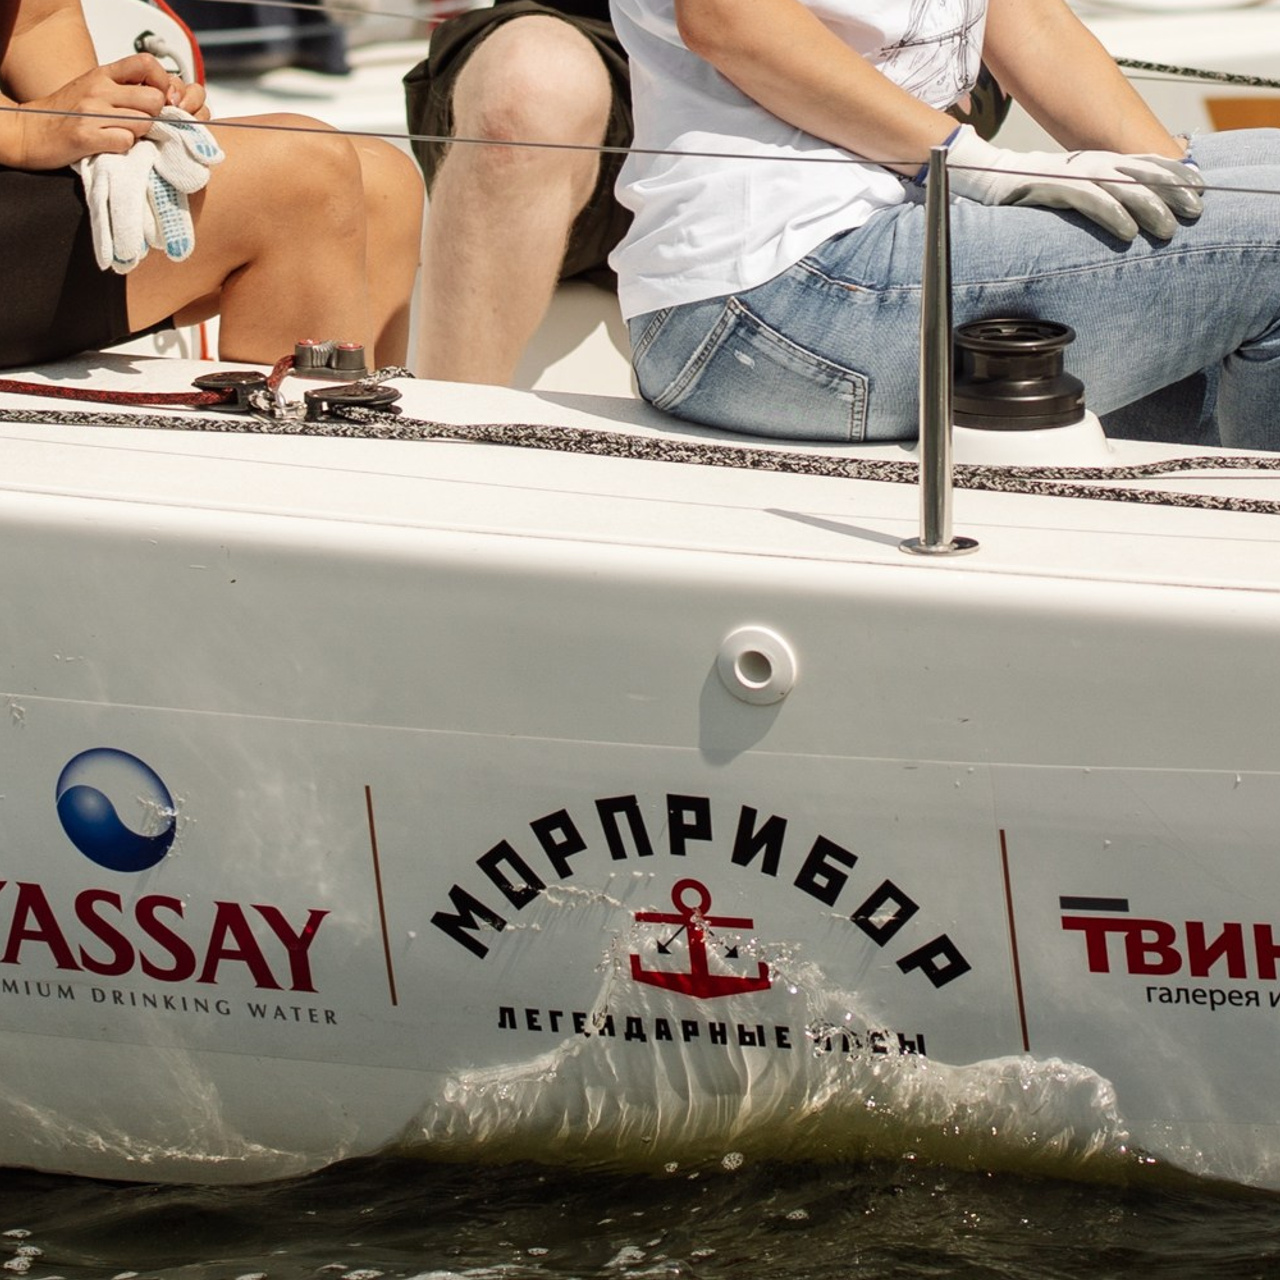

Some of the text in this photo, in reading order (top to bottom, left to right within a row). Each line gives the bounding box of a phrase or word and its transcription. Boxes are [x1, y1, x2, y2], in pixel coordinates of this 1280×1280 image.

[430, 793, 972, 989] МОРПРИБОР
[0, 880, 331, 993] ASSAY
[92, 987, 232, 1016] DRINKING
[247, 1002, 338, 1025] WATER
[1145, 984, 1260, 1011] галерея
